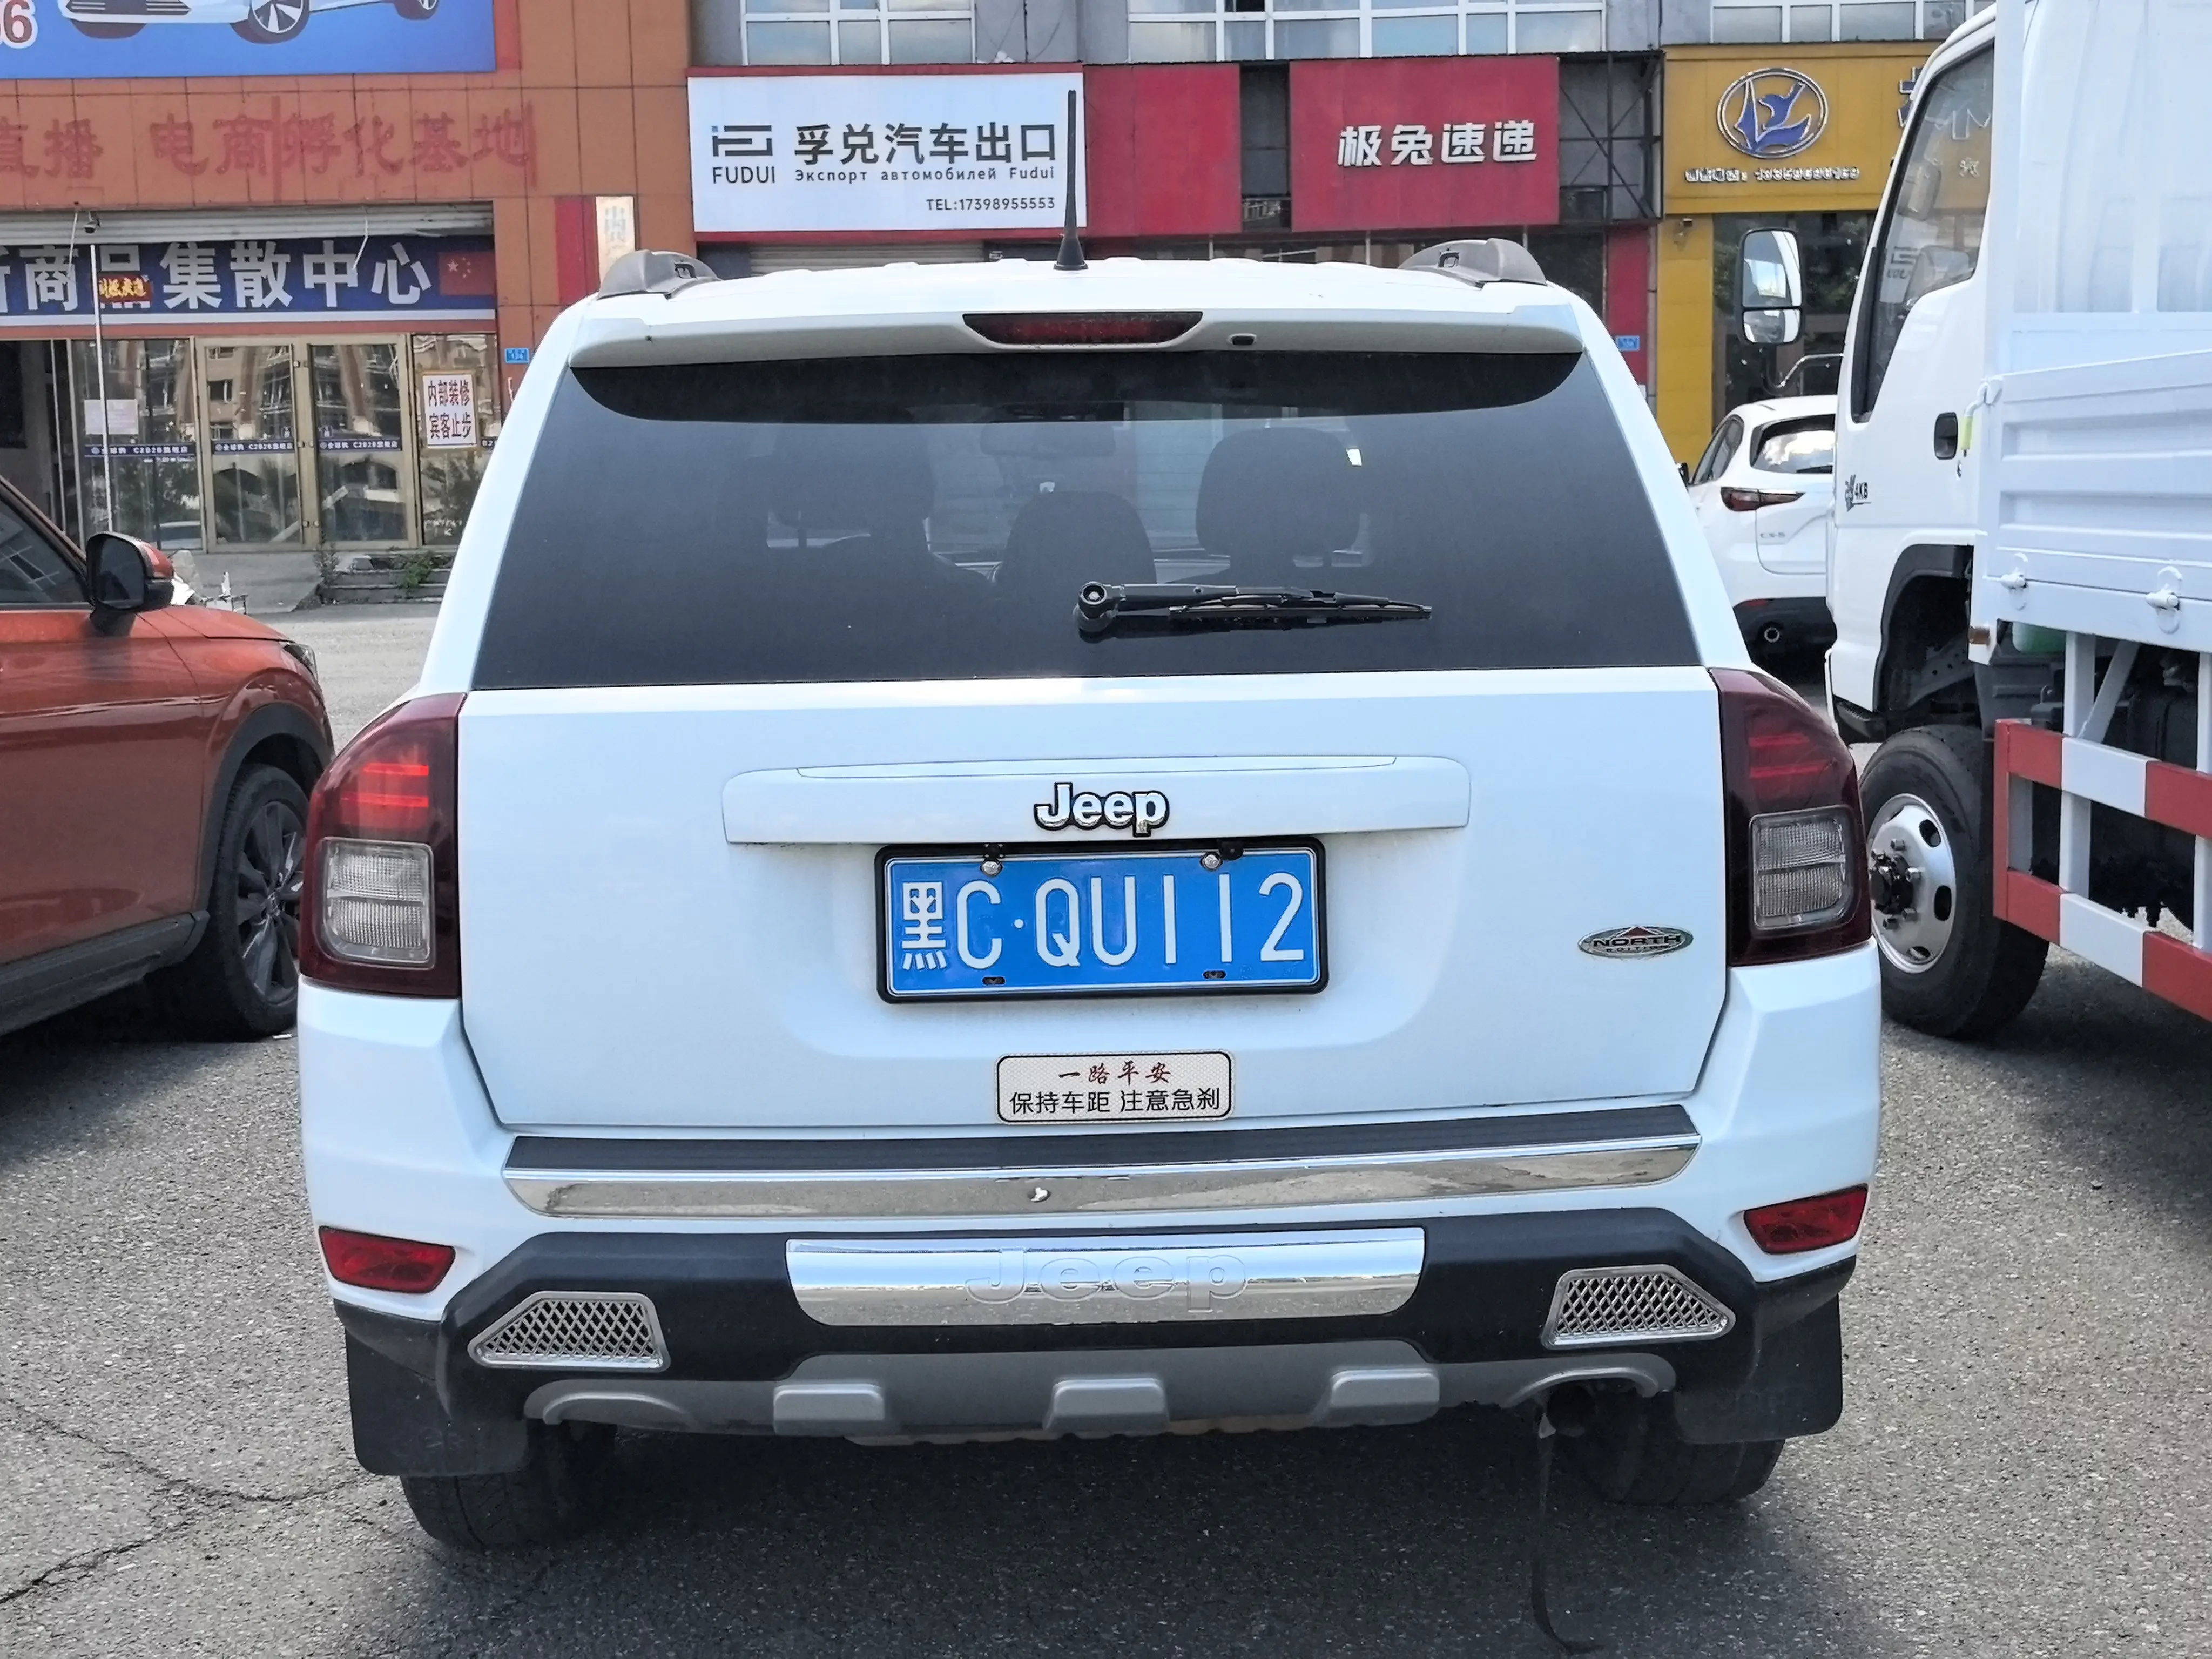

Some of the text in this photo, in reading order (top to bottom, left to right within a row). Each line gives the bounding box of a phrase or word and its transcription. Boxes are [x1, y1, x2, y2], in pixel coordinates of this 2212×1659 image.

[150, 109, 529, 176] 电商孵化基地
[794, 122, 1056, 165] 孚兑汽车出口
[1337, 119, 1538, 167] 极兔速递
[712, 166, 775, 184] FUDUI
[795, 166, 1055, 184] Экспорт автомобилей Fudui
[926, 197, 1055, 211] TEL:17398955553
[428, 380, 470, 407] 内部装修
[429, 412, 471, 439] 宾客止步
[1034, 781, 1170, 837] Jeep
[1593, 934, 1681, 947] NORTH
[1058, 1060, 1171, 1086] 一路平安
[1009, 1087, 1220, 1114] 保持车距 注意急刹
[965, 1246, 1247, 1313] Jeep
